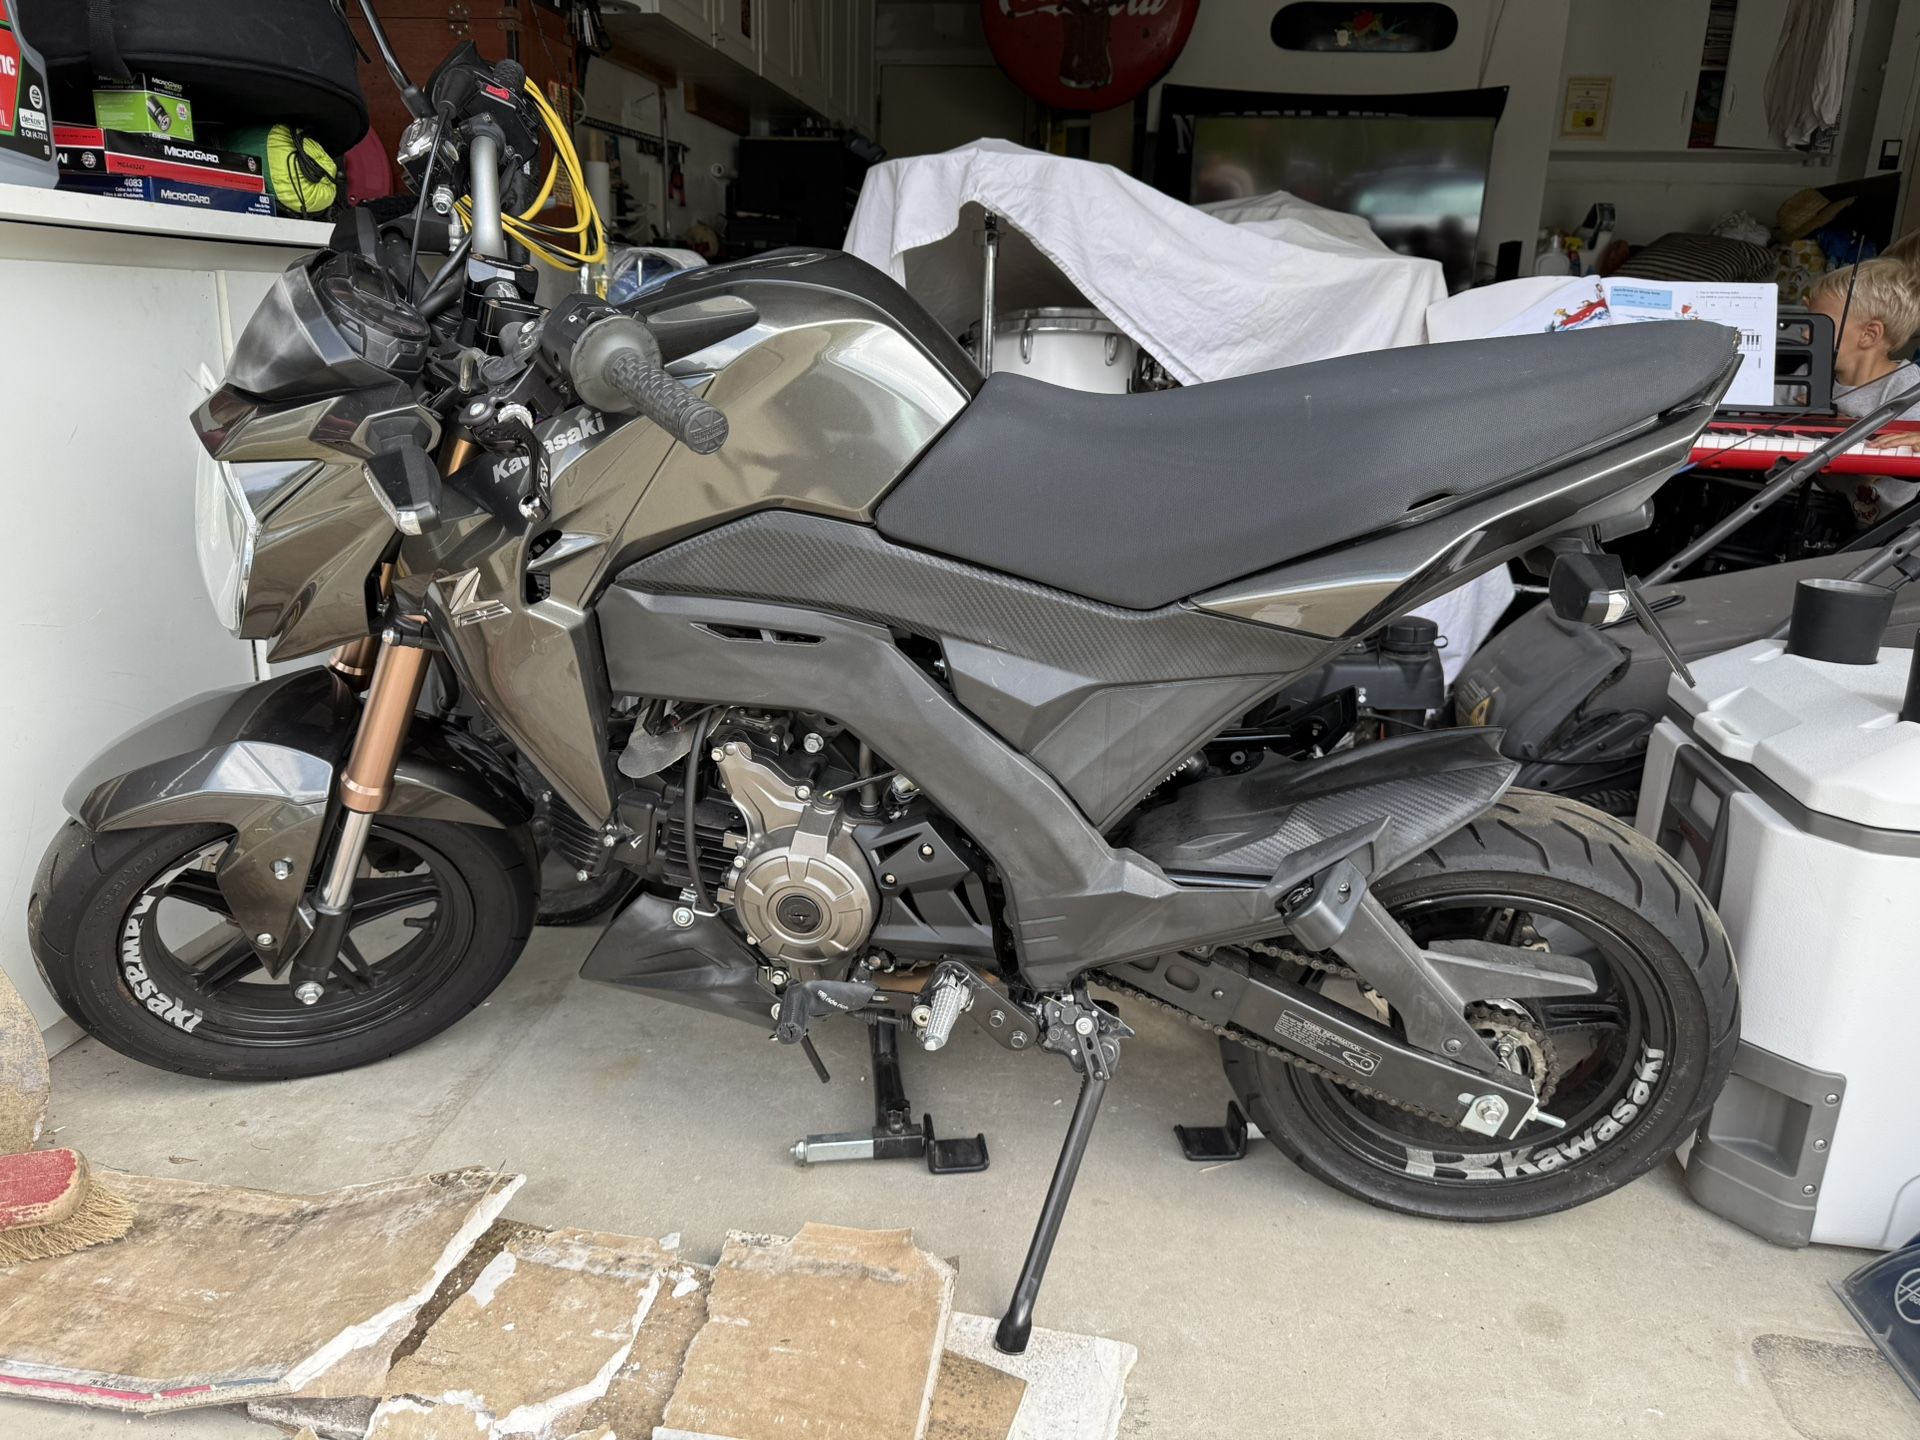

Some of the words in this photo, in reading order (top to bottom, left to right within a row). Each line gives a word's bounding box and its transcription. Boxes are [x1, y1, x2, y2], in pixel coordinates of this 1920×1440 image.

[164, 145, 219, 164] MICROGARD
[160, 189, 211, 204] MICROGARD
[122, 894, 203, 1033] Kawasaki
[1501, 1038, 1665, 1179] Kawasaki
